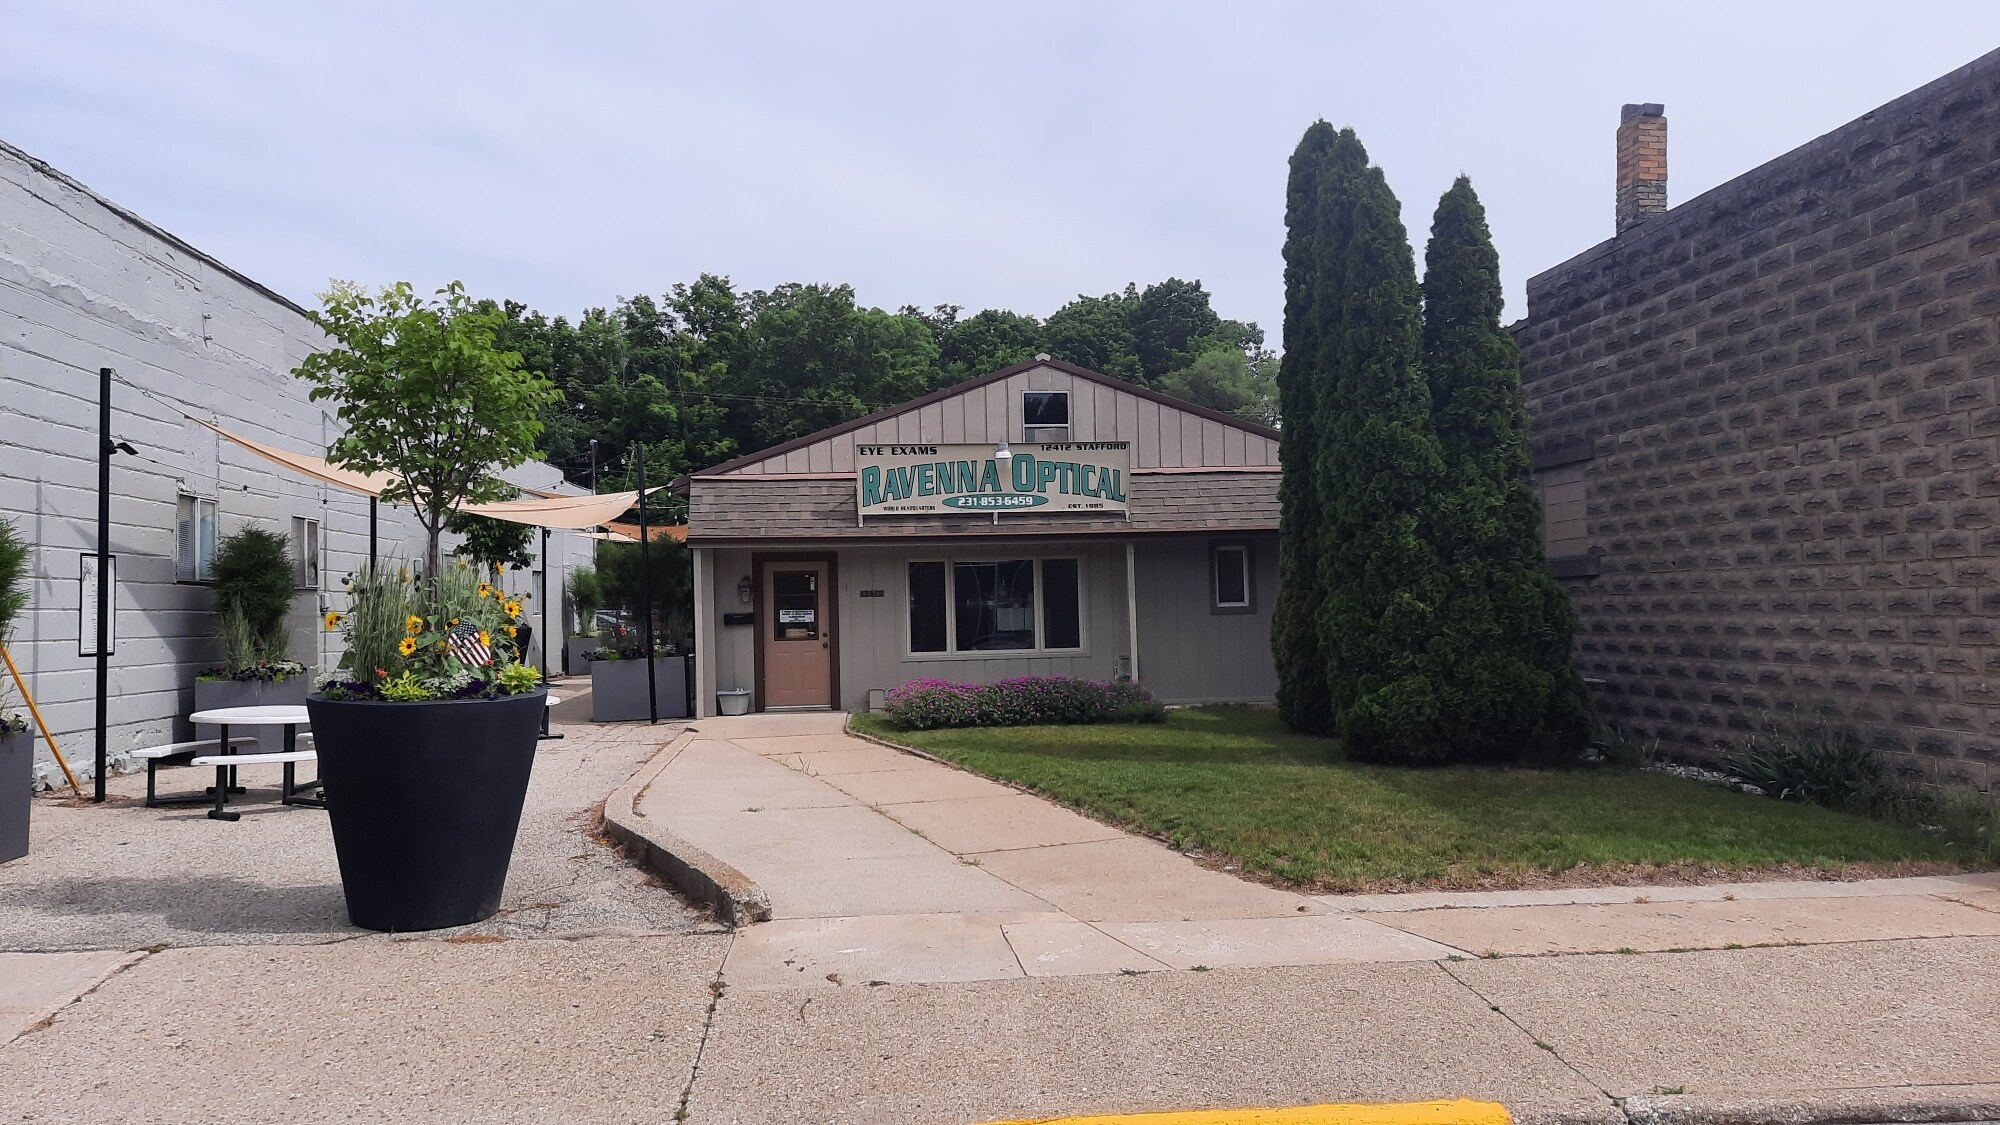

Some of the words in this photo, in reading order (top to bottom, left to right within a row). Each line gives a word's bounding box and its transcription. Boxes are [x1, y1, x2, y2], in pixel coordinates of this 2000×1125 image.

[860, 446, 884, 455] EYE
[891, 446, 938, 456] EXAMS
[1040, 443, 1072, 451] 12412
[1076, 443, 1127, 451] STAFFORD
[862, 460, 1002, 507] RAVENNA
[1012, 454, 1126, 503] OPTICAL
